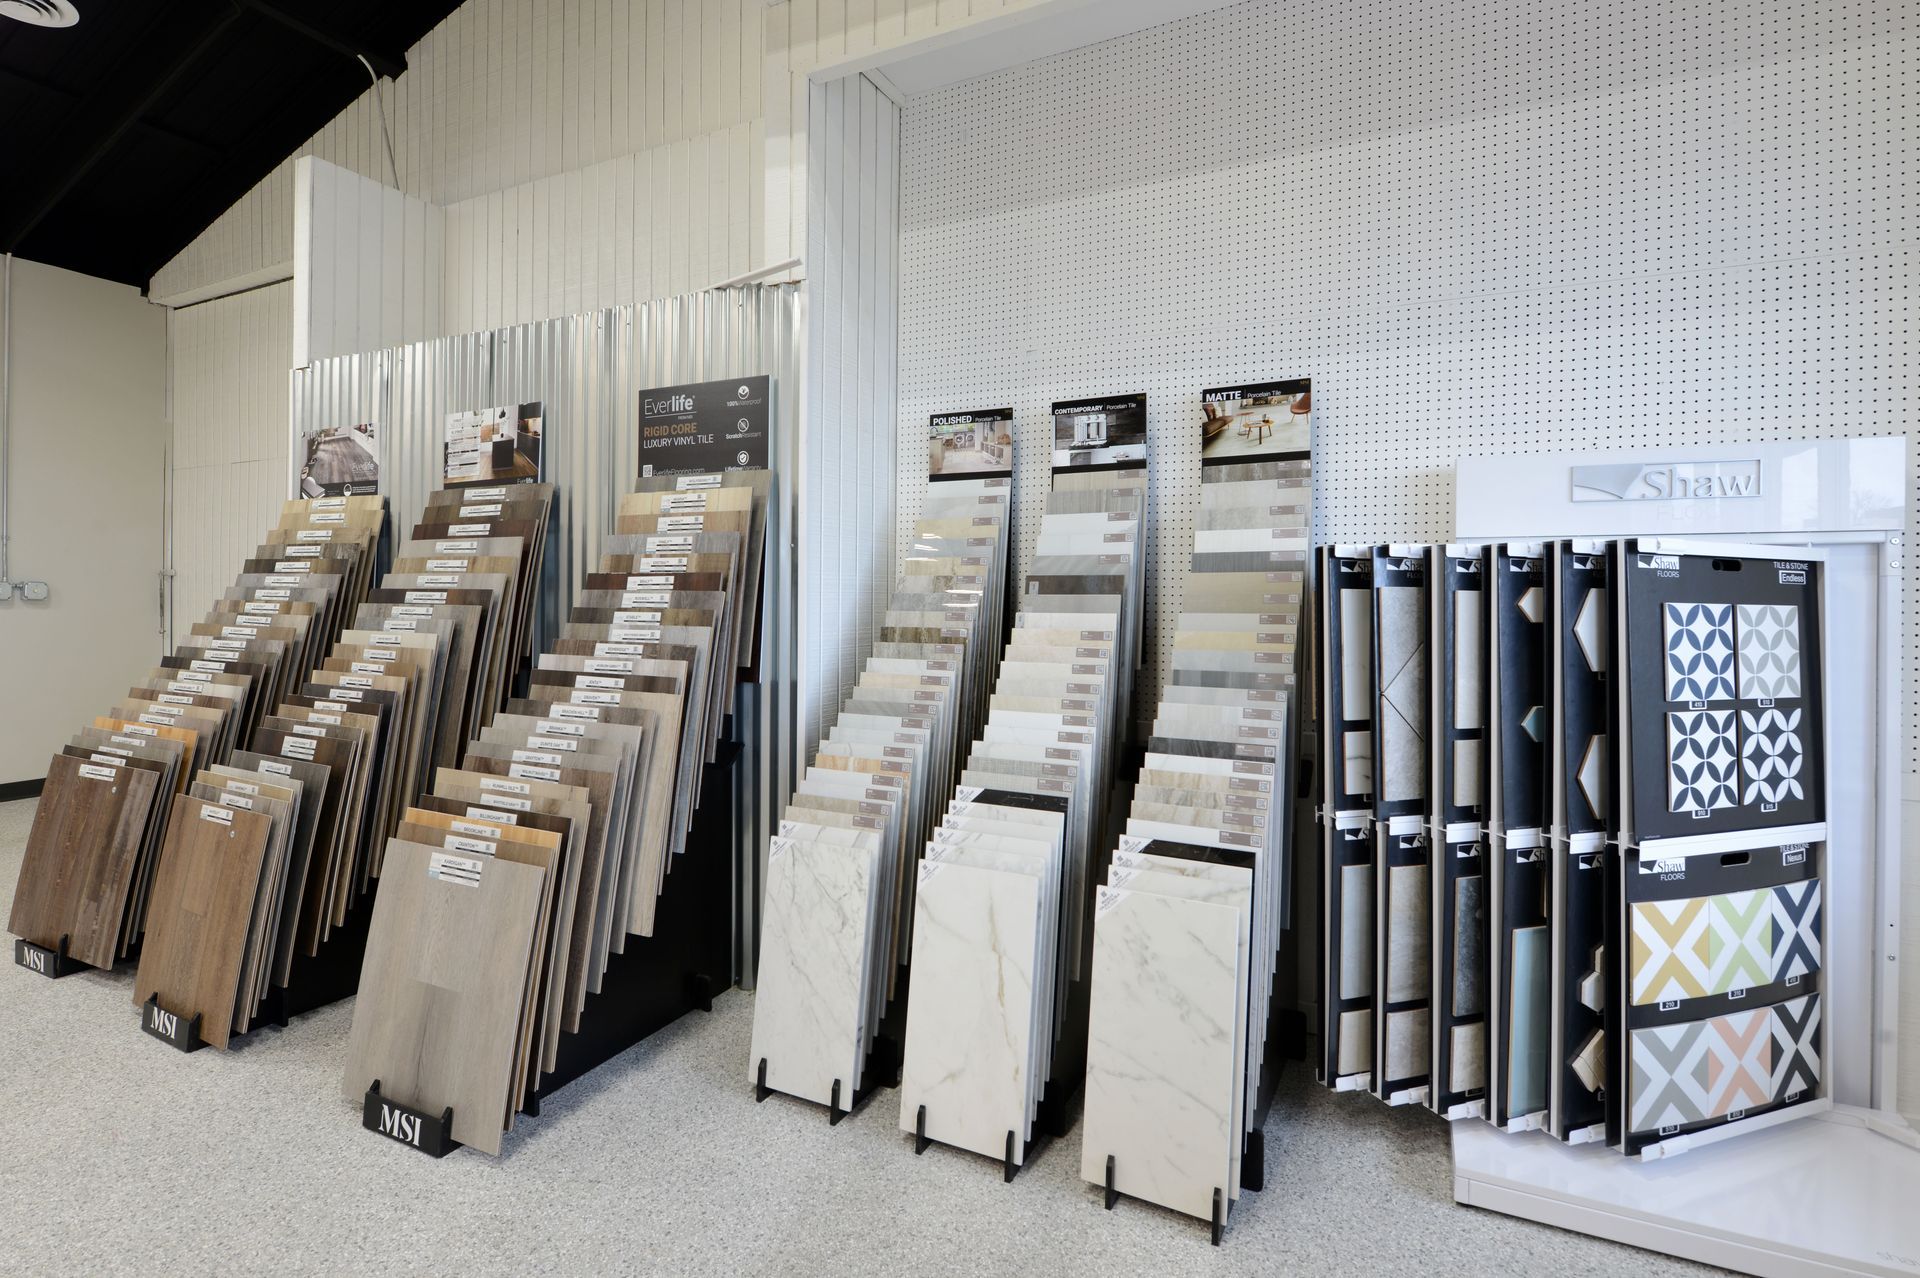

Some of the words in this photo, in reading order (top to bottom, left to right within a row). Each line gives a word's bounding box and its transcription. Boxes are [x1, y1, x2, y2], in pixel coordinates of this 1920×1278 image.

[1206, 390, 1241, 402] MATTE
[644, 394, 694, 415] Everlife
[1054, 405, 1103, 414] CONTEMPORARY
[933, 415, 972, 426] POLISHED
[644, 425, 669, 437] RIGID
[671, 422, 697, 435] CORE
[643, 438, 672, 449] LUXURY
[673, 436, 695, 446] VINYL
[697, 434, 714, 444] TILE
[1644, 467, 1754, 499] Shaw
[1654, 556, 1679, 569] Shaw
[1773, 561, 1785, 569] TILE
[1657, 570, 1680, 578] FLOORS
[1782, 573, 1804, 583] Endless
[1658, 860, 1683, 873] Shaw
[1660, 873, 1685, 881] FLOORS
[23, 946, 45, 973] MSI
[150, 1006, 177, 1039] MSI
[378, 1103, 422, 1147] MSI
